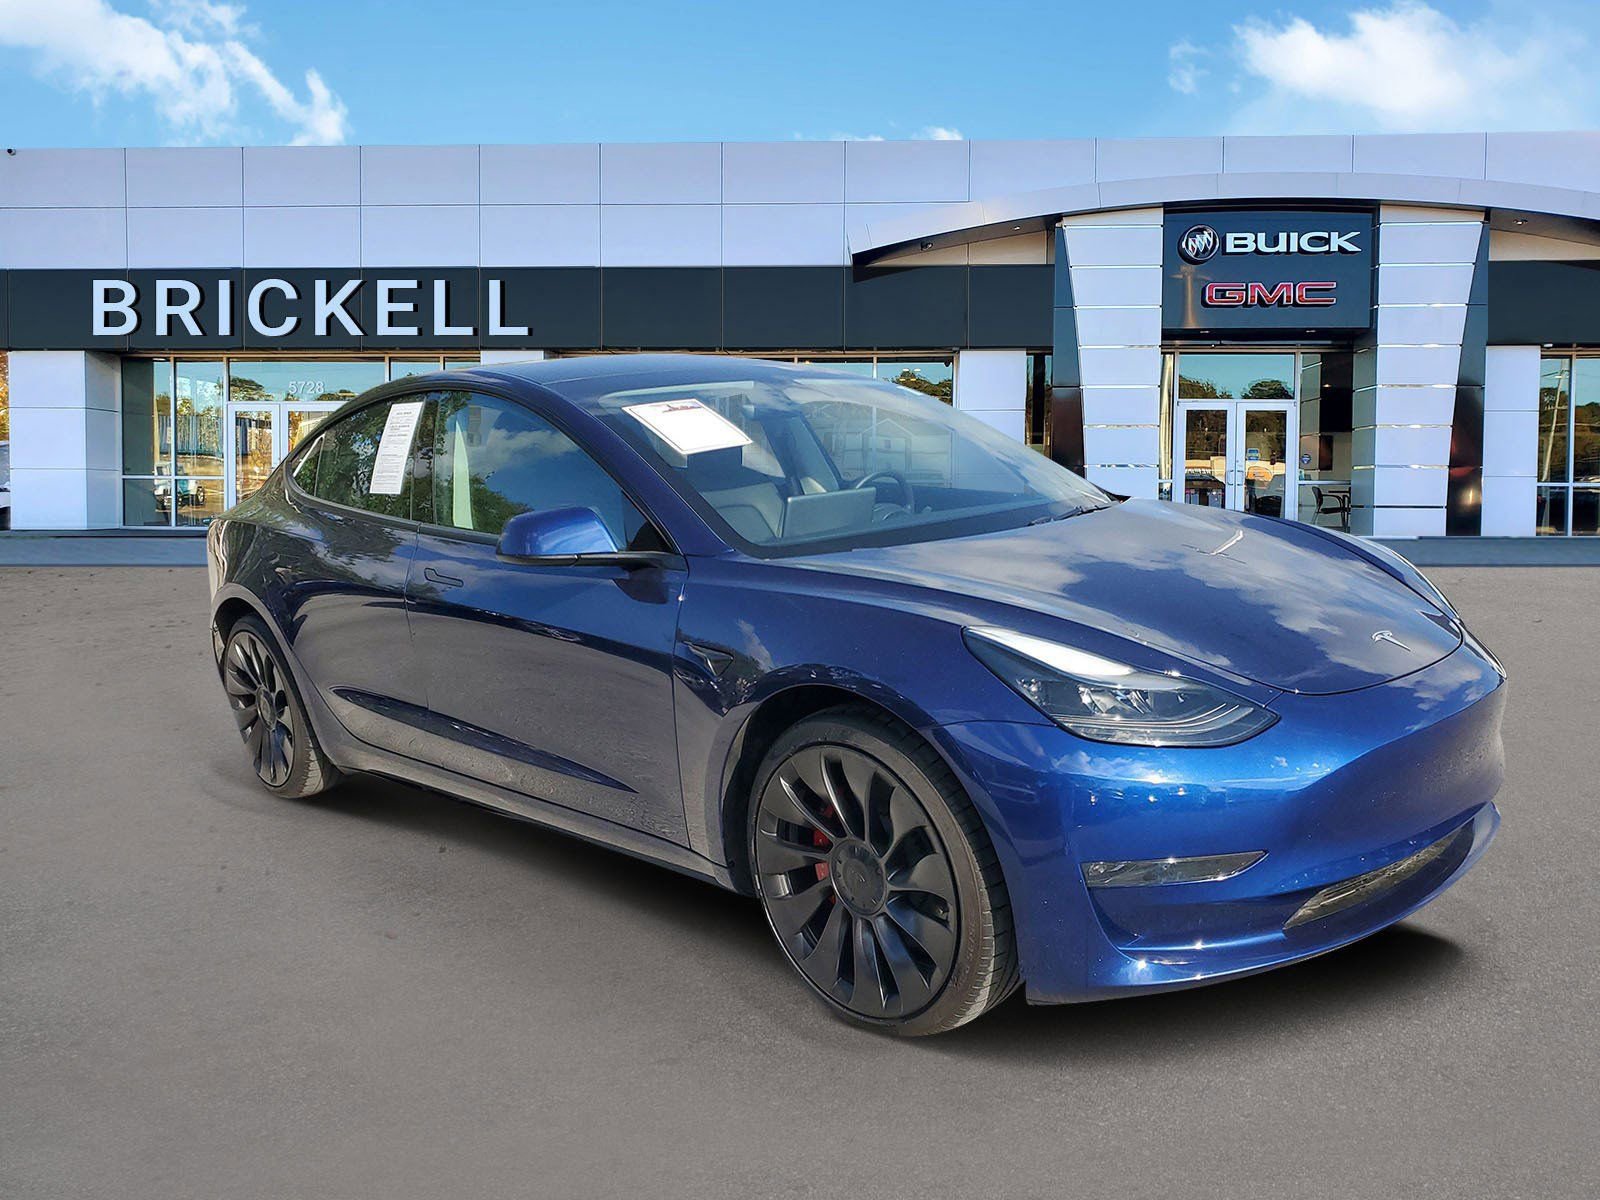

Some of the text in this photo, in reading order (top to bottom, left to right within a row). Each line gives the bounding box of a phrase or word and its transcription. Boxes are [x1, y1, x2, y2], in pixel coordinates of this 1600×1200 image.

[1225, 231, 1362, 253] BUICK
[1205, 282, 1337, 305] GMC
[92, 279, 531, 337] BRICKELL
[288, 381, 325, 394] 5728
